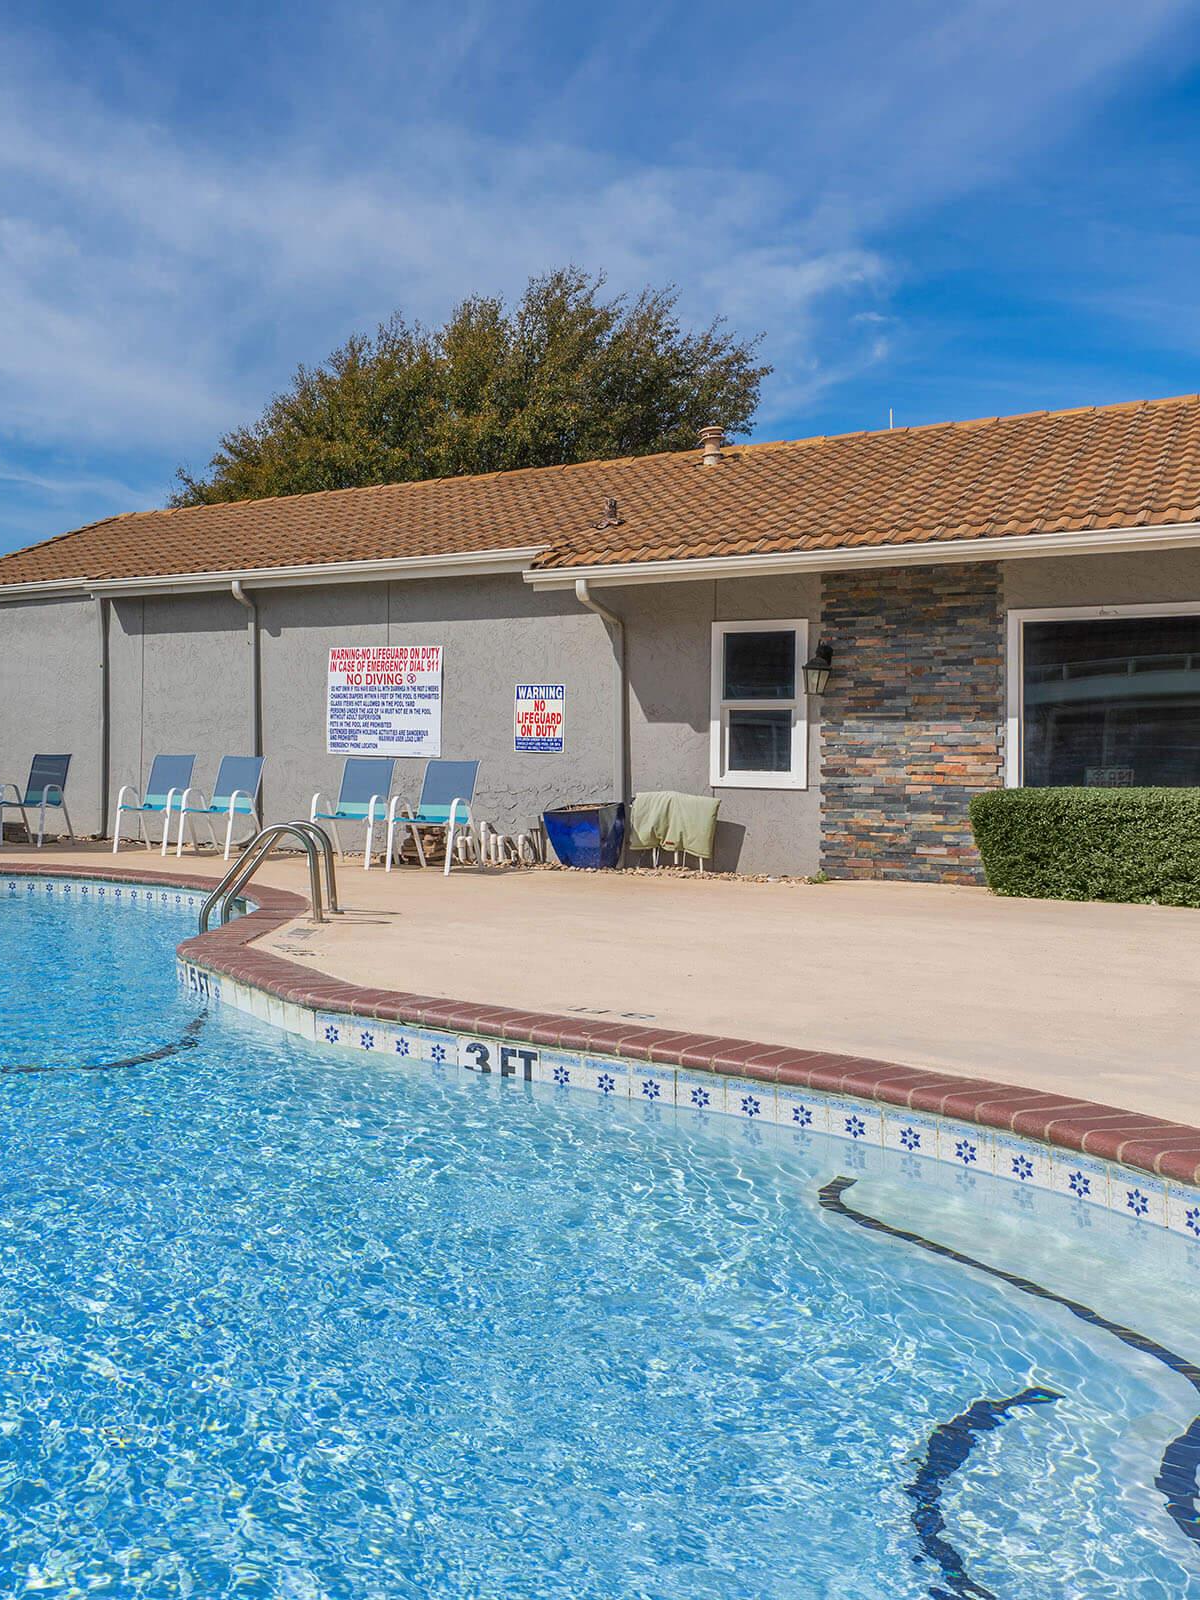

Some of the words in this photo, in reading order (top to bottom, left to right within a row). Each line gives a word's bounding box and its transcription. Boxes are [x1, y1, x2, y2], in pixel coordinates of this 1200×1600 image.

[372, 648, 408, 660] LIFEGUARD
[410, 648, 420, 659] ON
[422, 648, 440, 659] DUTY
[330, 662, 336, 672] IN
[338, 662, 354, 672] CASE
[357, 661, 365, 672] OF
[367, 661, 408, 672] EMERGENCY
[410, 661, 424, 672] DIAL
[427, 660, 439, 672] 911
[346, 673, 362, 685] NO
[366, 673, 402, 685] DIVING
[519, 686, 562, 699] WARNING
[534, 700, 546, 712] NO
[517, 712, 562, 724] LIFEGUARD
[521, 725, 532, 736] ON
[536, 725, 557, 736] DUTY
[464, 1042, 492, 1073] 3
[501, 1047, 538, 1082] FT
